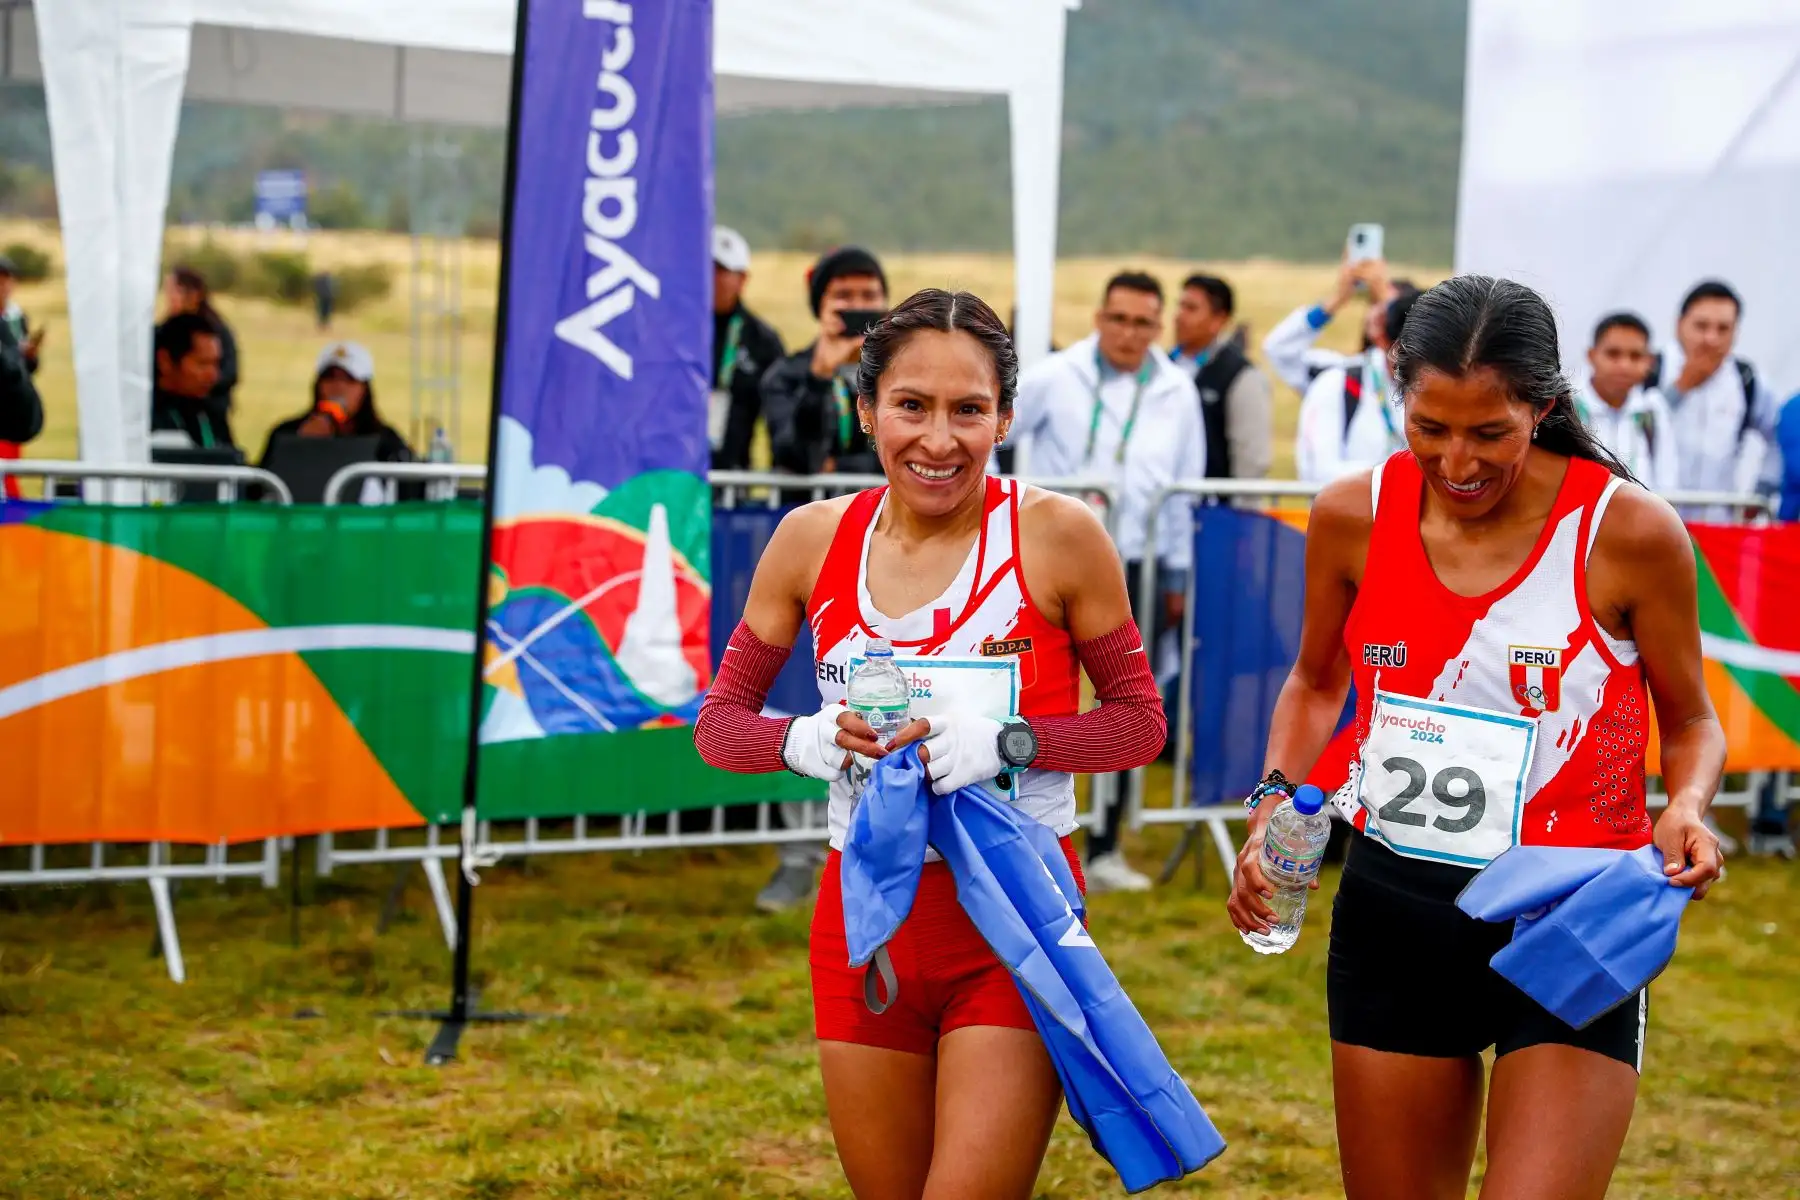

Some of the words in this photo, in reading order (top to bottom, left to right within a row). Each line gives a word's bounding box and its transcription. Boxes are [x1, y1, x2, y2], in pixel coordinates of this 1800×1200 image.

[1363, 641, 1407, 668] PERÚ
[1514, 650, 1555, 666] PERÚ
[1409, 729, 1444, 745] 2024
[1378, 756, 1486, 834] 29
